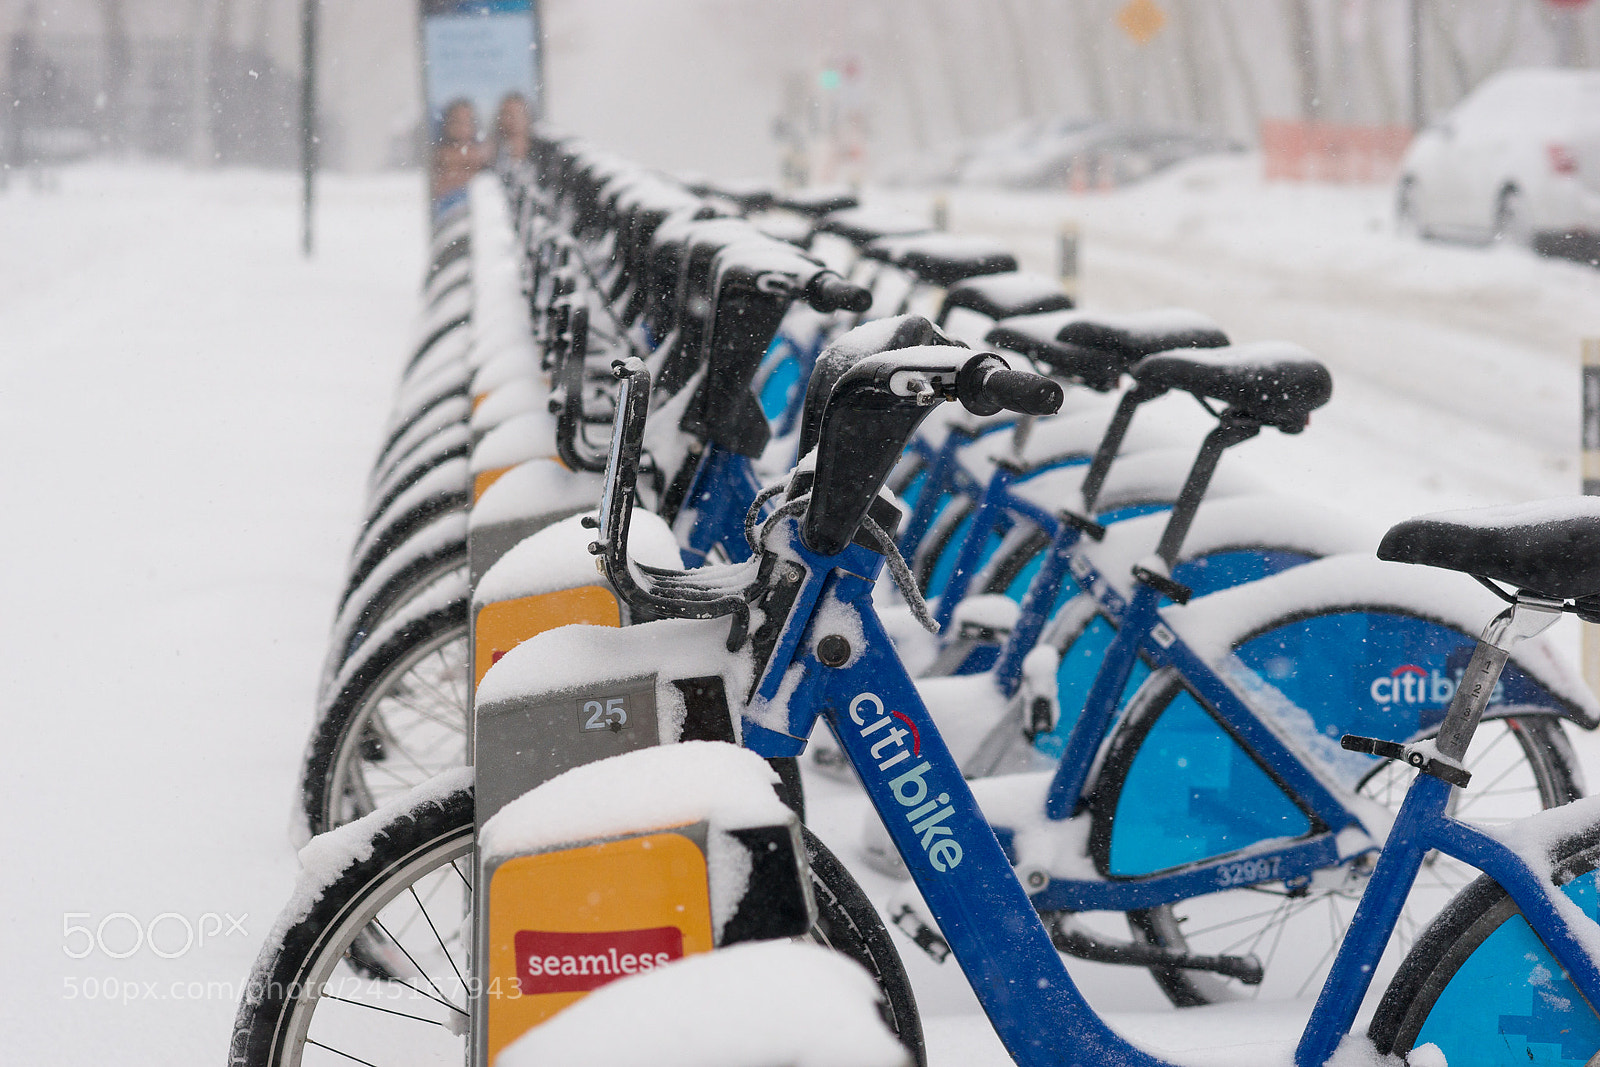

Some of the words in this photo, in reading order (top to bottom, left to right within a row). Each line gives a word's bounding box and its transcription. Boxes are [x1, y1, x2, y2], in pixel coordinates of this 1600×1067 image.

[1474, 683, 1482, 694] 2
[583, 698, 627, 730] 25
[1216, 856, 1280, 887] 32997
[528, 948, 669, 976] seamless
